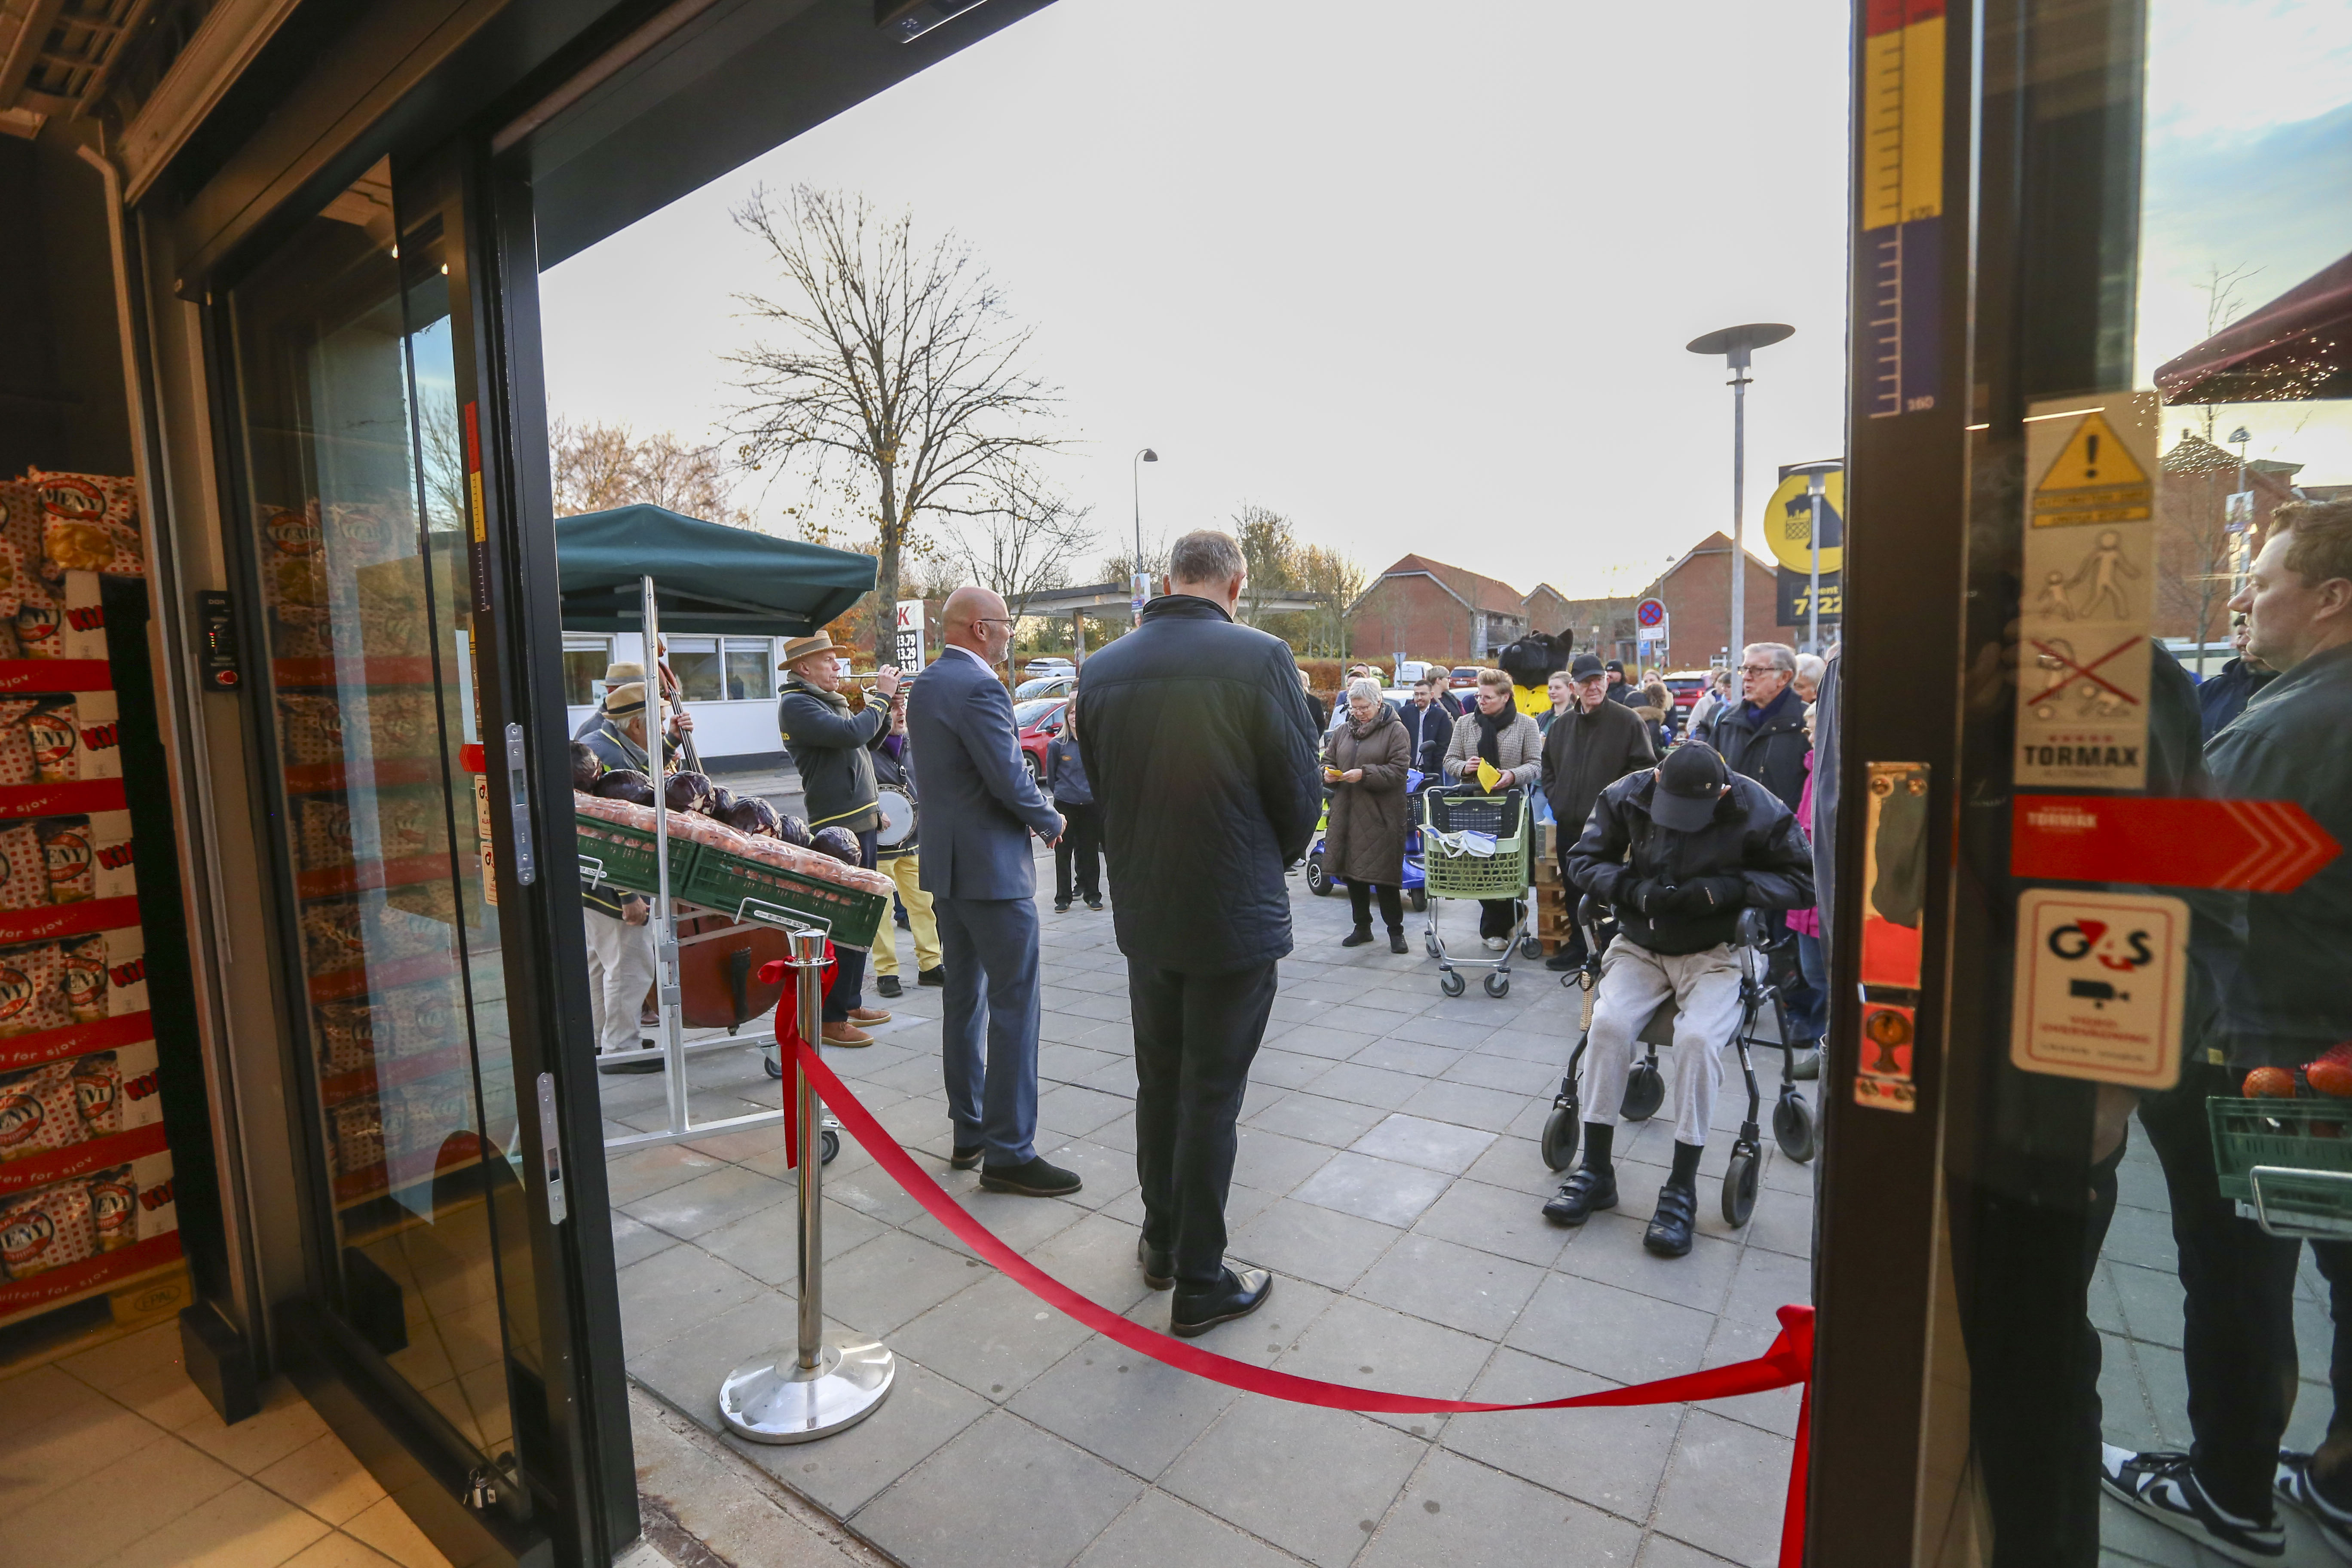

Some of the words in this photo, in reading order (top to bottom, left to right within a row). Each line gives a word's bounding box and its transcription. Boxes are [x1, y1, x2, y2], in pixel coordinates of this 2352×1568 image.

[897, 634, 916, 647] 13.79
[897, 647, 917, 661] 13.29
[901, 660, 917, 672] 3.19
[31, 731, 68, 747] ENY
[2024, 745, 2139, 768] TORMAX
[47, 848, 83, 864] ENY
[2048, 918, 2154, 973] G4S
[68, 974, 100, 989] ENY
[97, 1196, 129, 1213] ENY
[48, 1285, 70, 1296] for
[141, 1291, 174, 1308] EPAL
